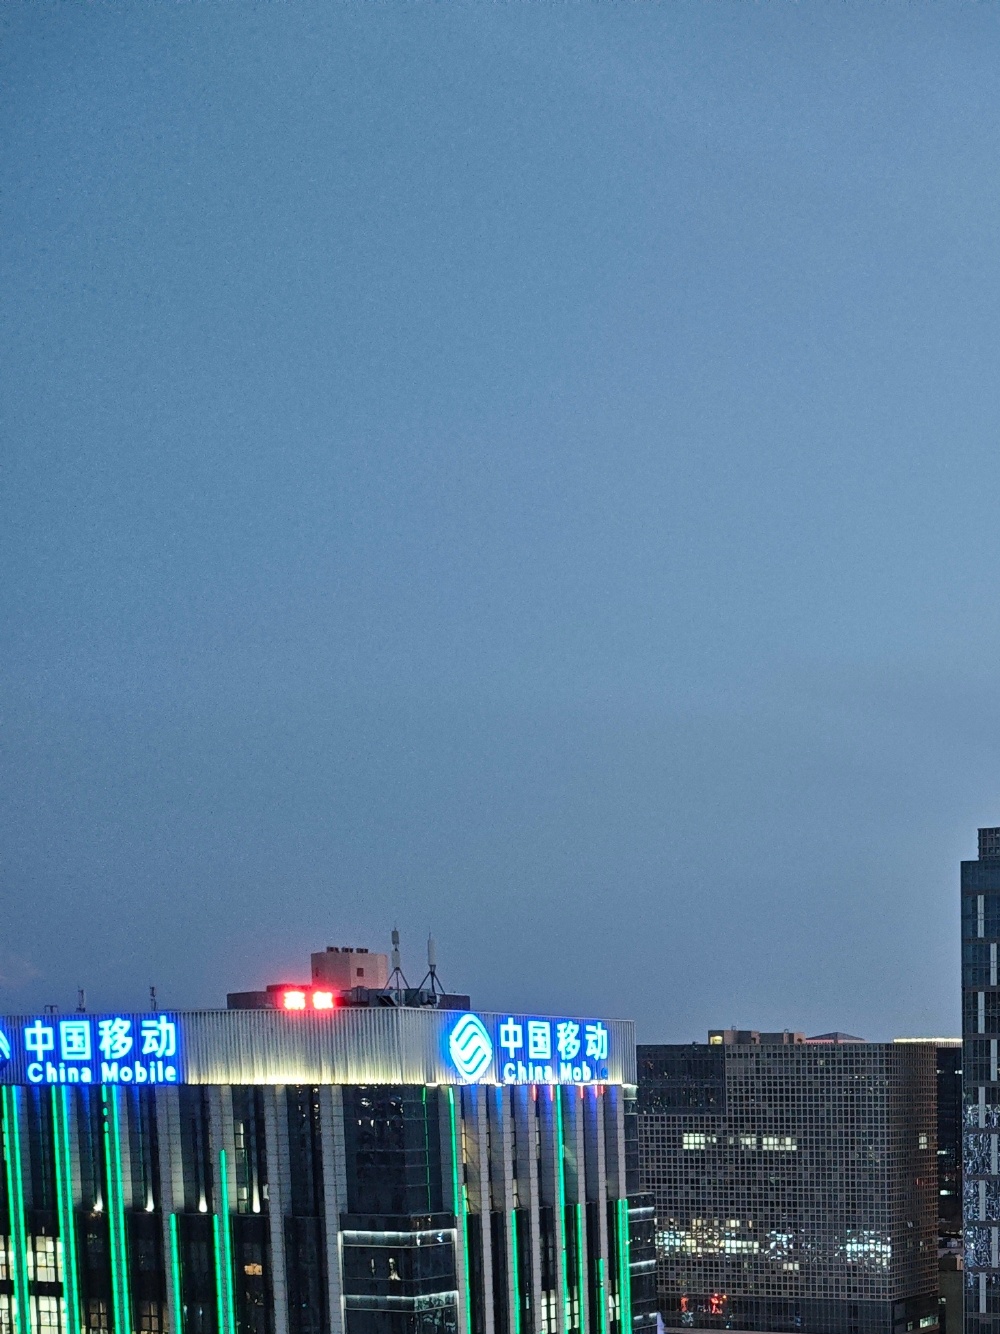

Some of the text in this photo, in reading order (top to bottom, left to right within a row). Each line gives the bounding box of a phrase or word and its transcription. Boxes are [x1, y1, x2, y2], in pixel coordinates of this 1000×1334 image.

[24, 1015, 176, 1061] 中国移动
[500, 1017, 608, 1061] 中国移动
[27, 1060, 177, 1083] China Mobile
[503, 1060, 609, 1082] China Mobe
